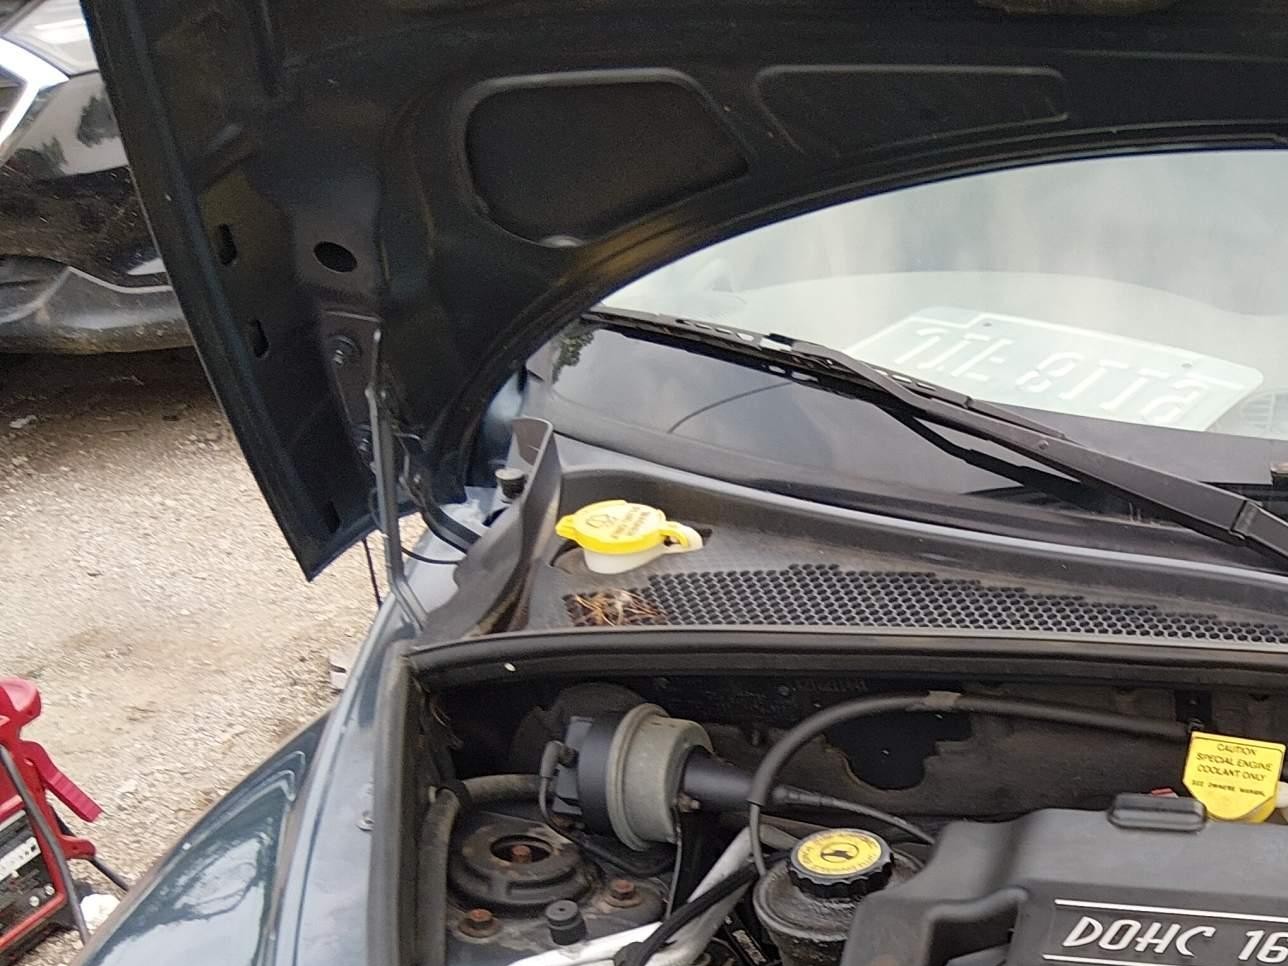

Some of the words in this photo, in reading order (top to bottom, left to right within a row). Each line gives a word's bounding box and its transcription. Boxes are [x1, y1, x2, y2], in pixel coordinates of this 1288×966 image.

[1216, 743, 1257, 756] CAUTION
[1195, 752, 1234, 766] SPECIAL
[1236, 759, 1273, 772] ENGINE
[1196, 764, 1241, 777] COOLANT
[1241, 770, 1266, 782] ONLY
[1061, 916, 1217, 959] DOHC
